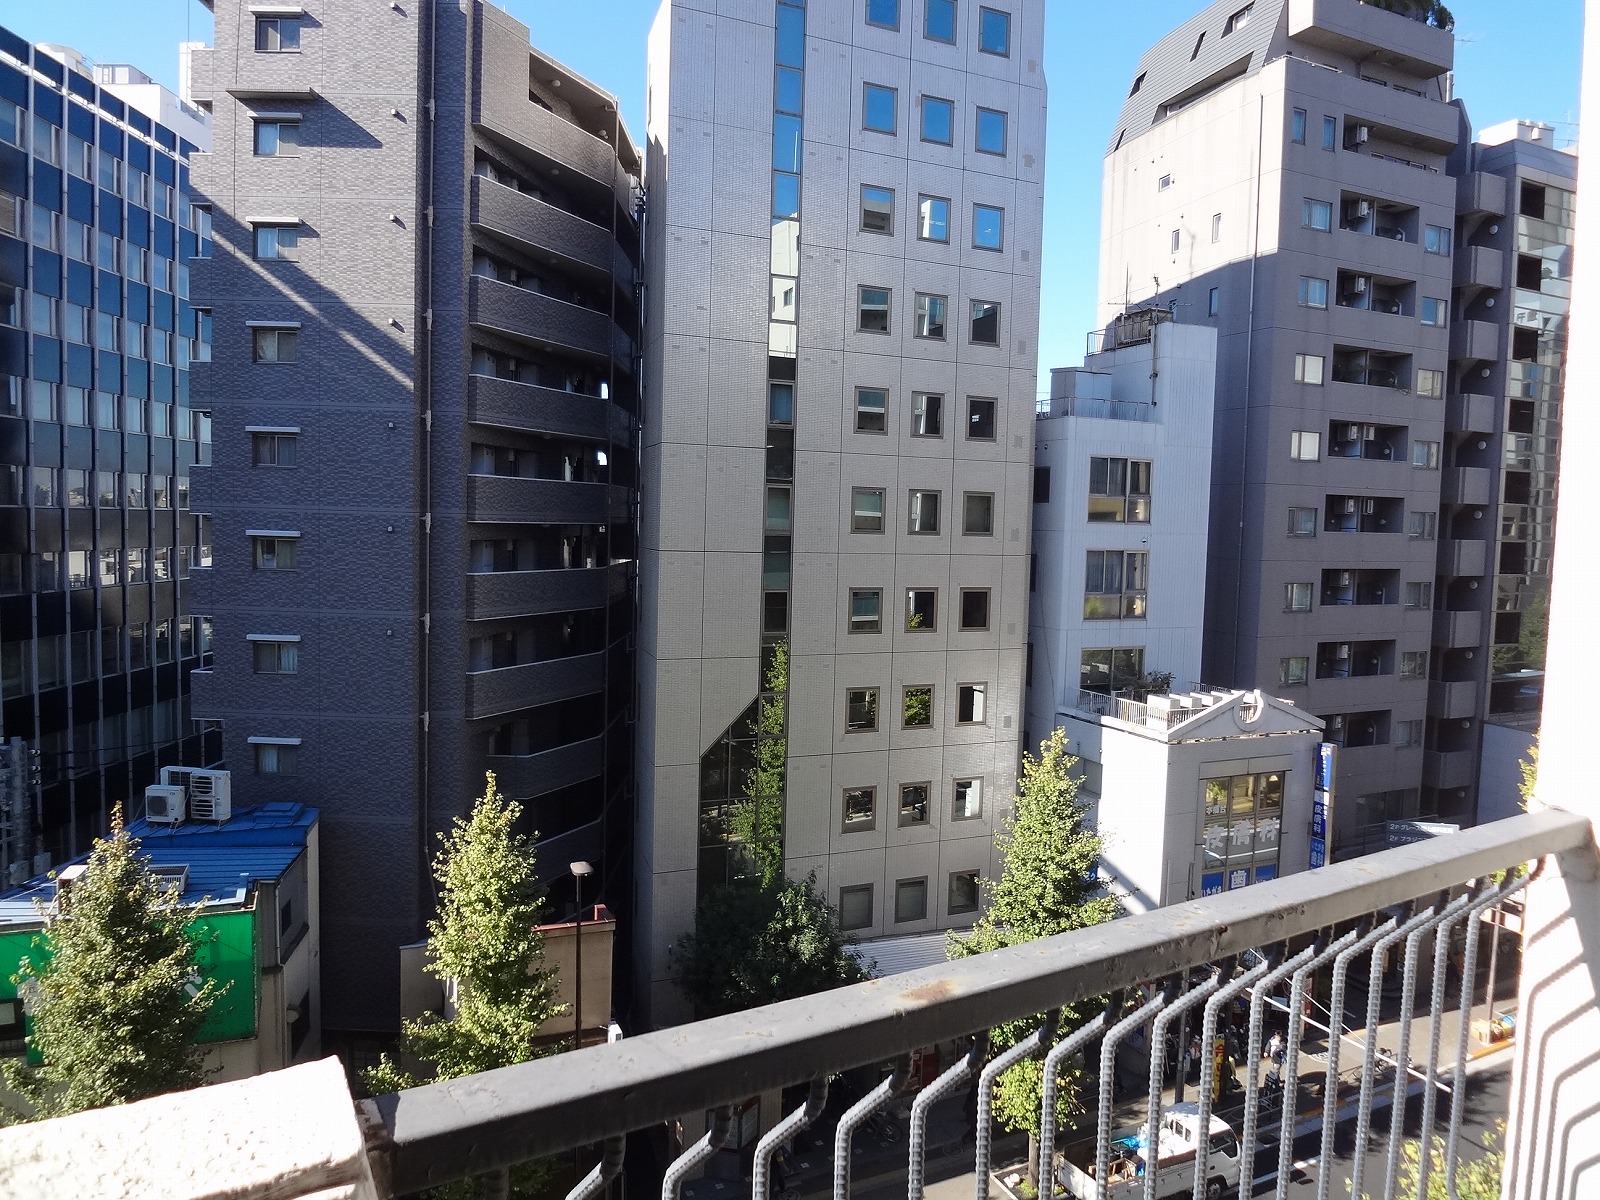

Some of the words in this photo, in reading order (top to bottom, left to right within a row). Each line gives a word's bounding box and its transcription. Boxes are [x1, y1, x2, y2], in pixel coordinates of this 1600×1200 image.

[1206, 817, 1277, 849] 皮膚科
[1313, 804, 1323, 834] 皮膚科
[1231, 870, 1247, 888] 歯
